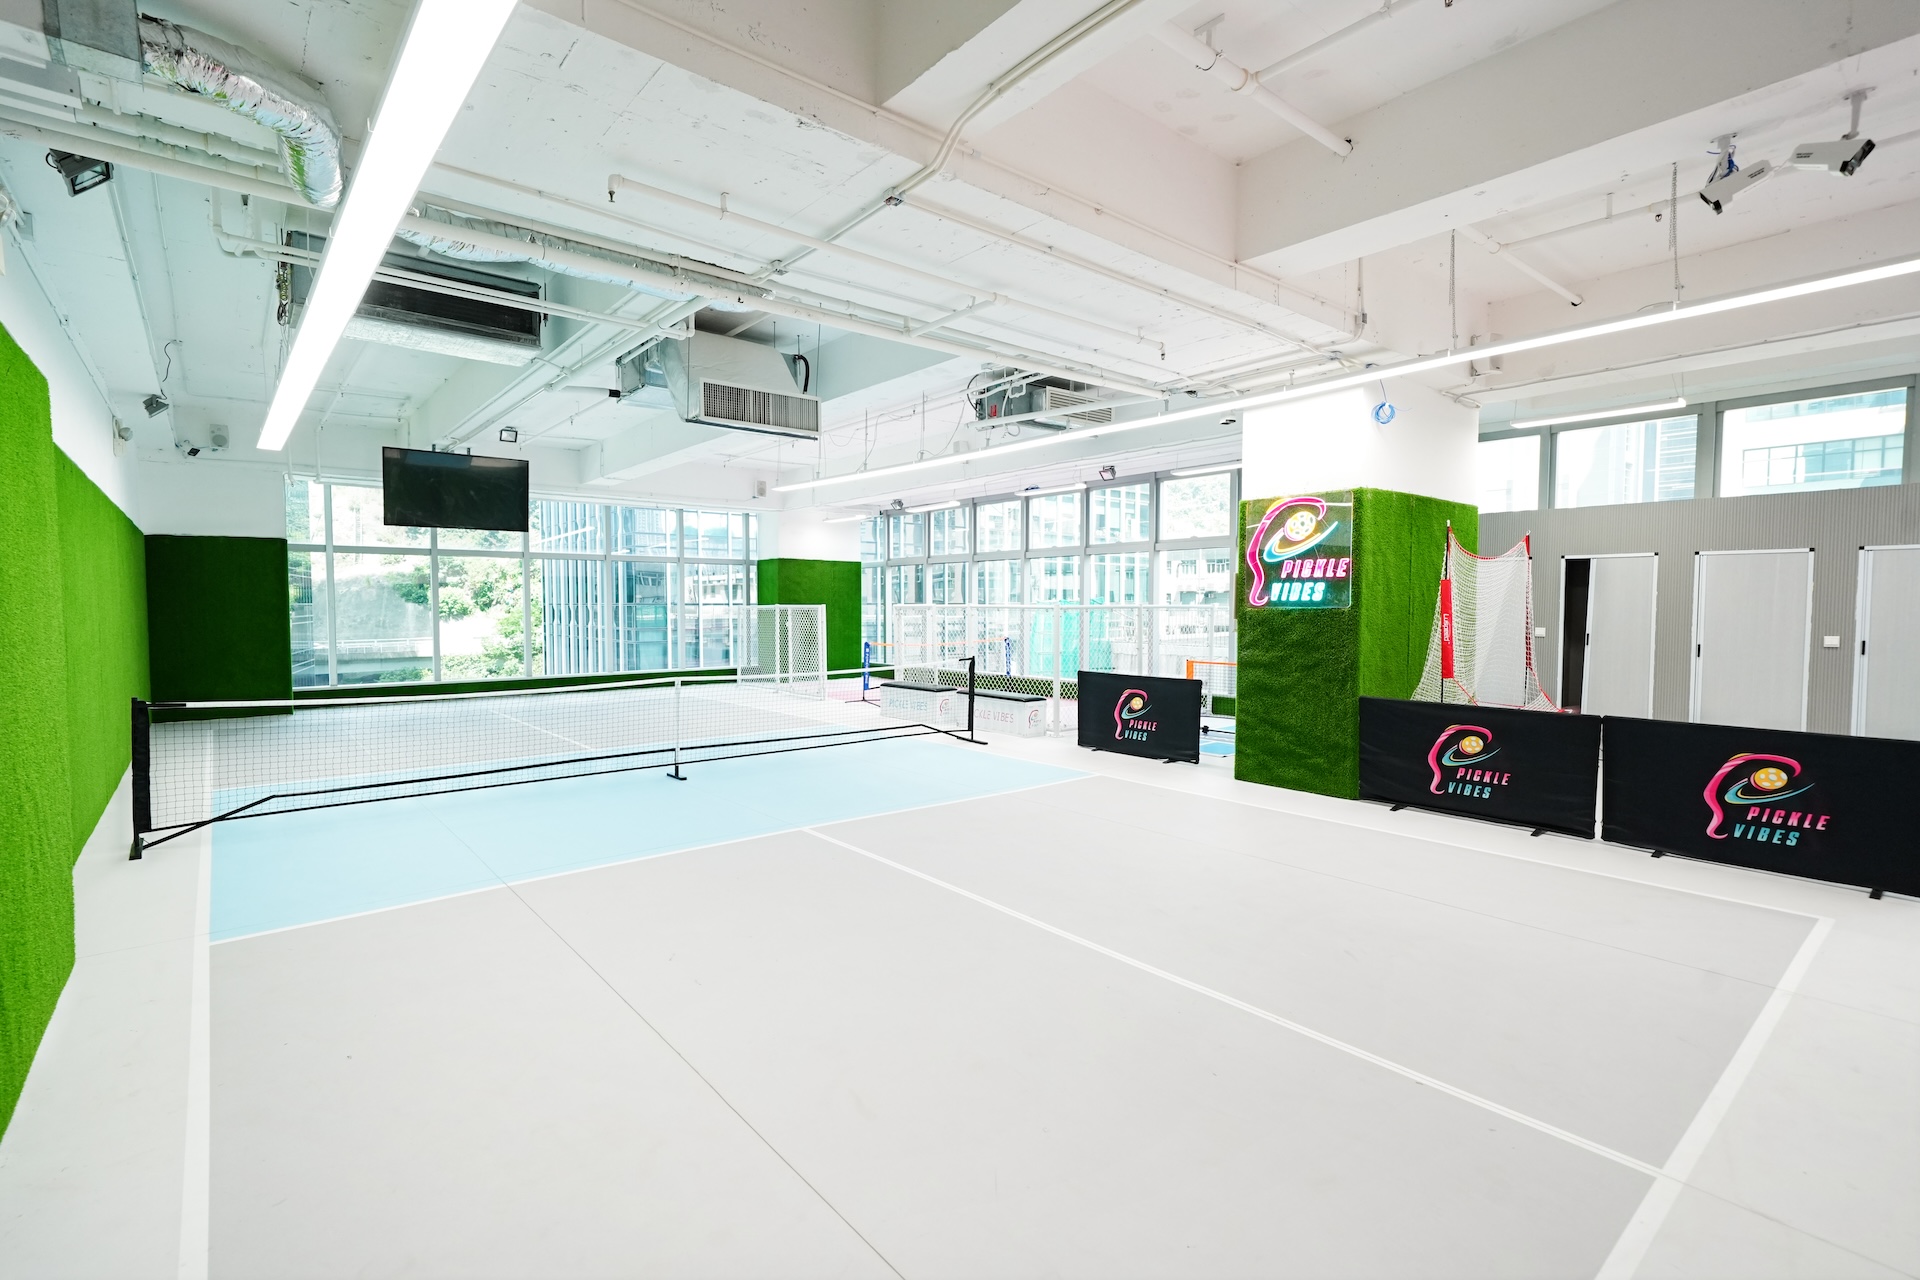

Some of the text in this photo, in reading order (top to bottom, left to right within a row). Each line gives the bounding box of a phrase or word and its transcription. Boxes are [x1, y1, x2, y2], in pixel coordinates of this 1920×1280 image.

[1280, 557, 1350, 579] PICKLE
[1270, 581, 1326, 602] VIBES
[974, 708, 1014, 723] CKLE VIBES
[1129, 719, 1158, 731] PICKLE
[1124, 729, 1148, 741] VIBES
[1456, 767, 1512, 786] PICKLE
[1447, 781, 1492, 799] VIBES
[1746, 806, 1831, 831] PICKLE
[1733, 823, 1801, 847] VIBES
